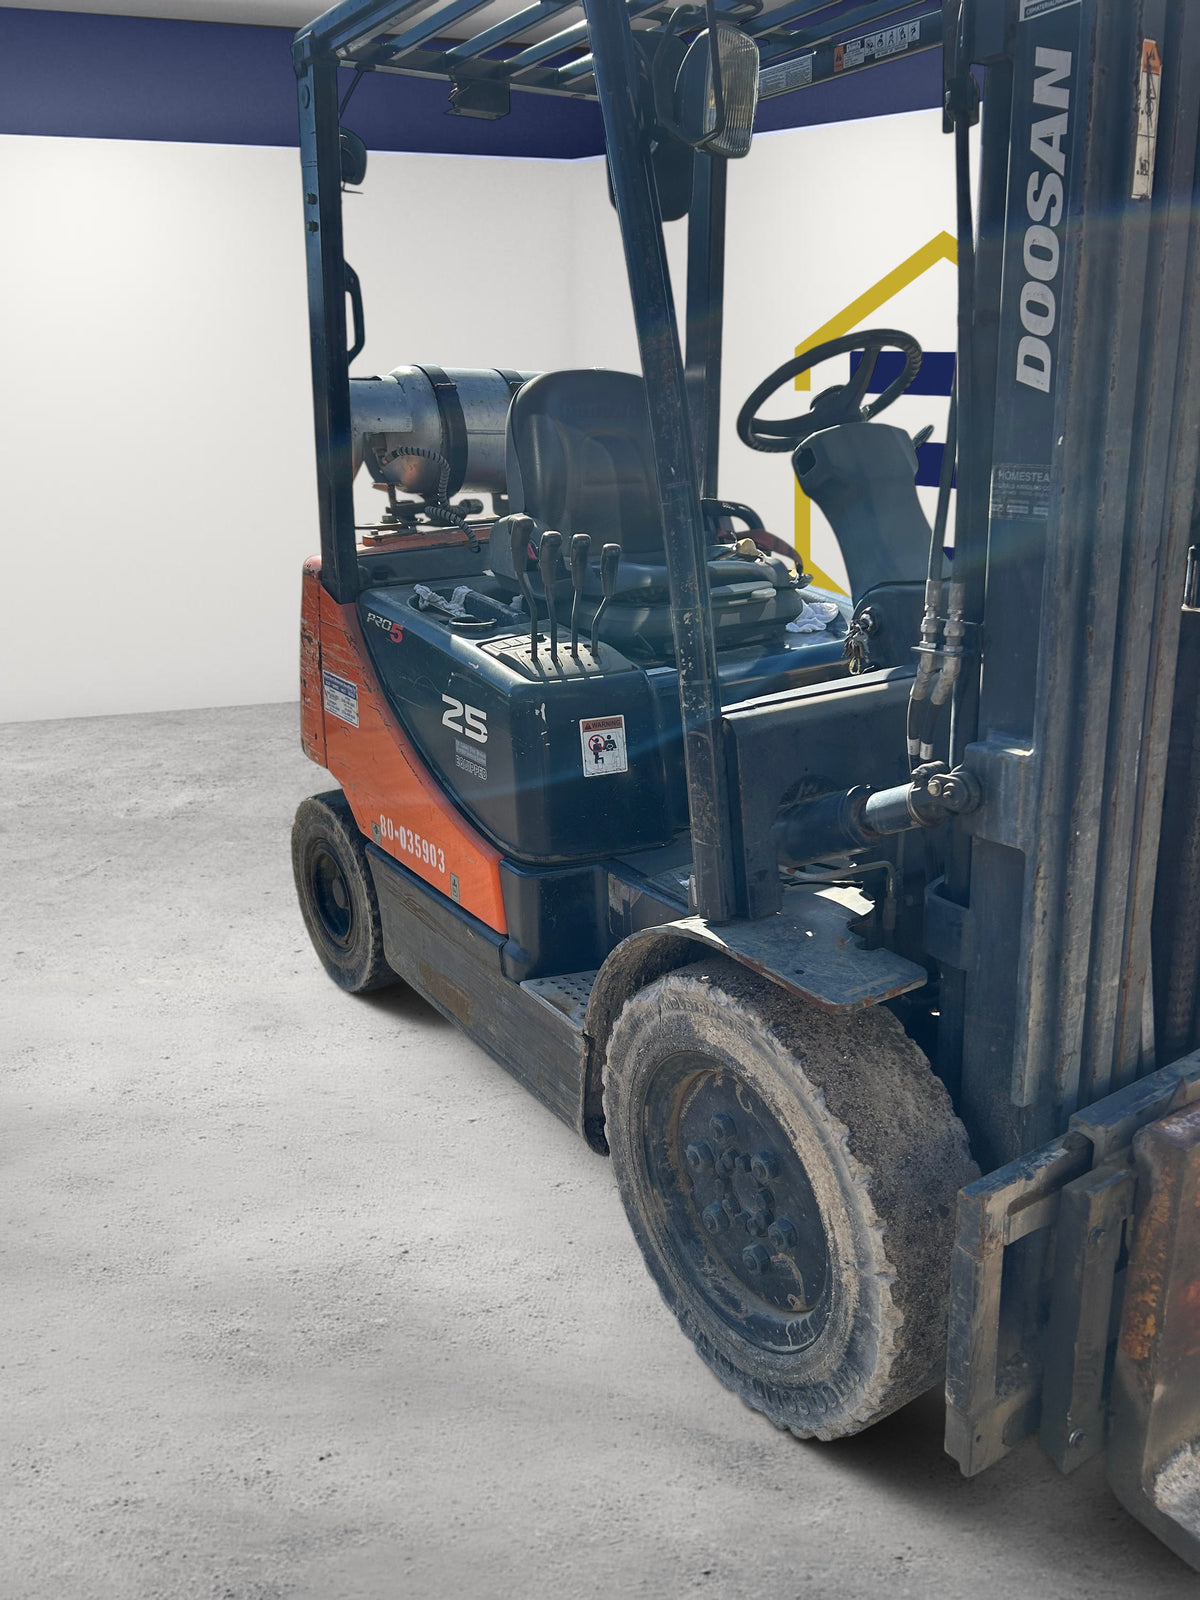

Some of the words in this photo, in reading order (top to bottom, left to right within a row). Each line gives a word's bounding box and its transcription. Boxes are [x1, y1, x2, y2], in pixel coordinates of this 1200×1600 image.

[1016, 46, 1073, 394] DOOSAN
[998, 471, 1050, 482] HOMESTEA
[441, 693, 489, 744] 25
[591, 719, 621, 729] WARNING
[455, 754, 488, 781] EQUIPPED
[380, 814, 446, 874] 80-035903
